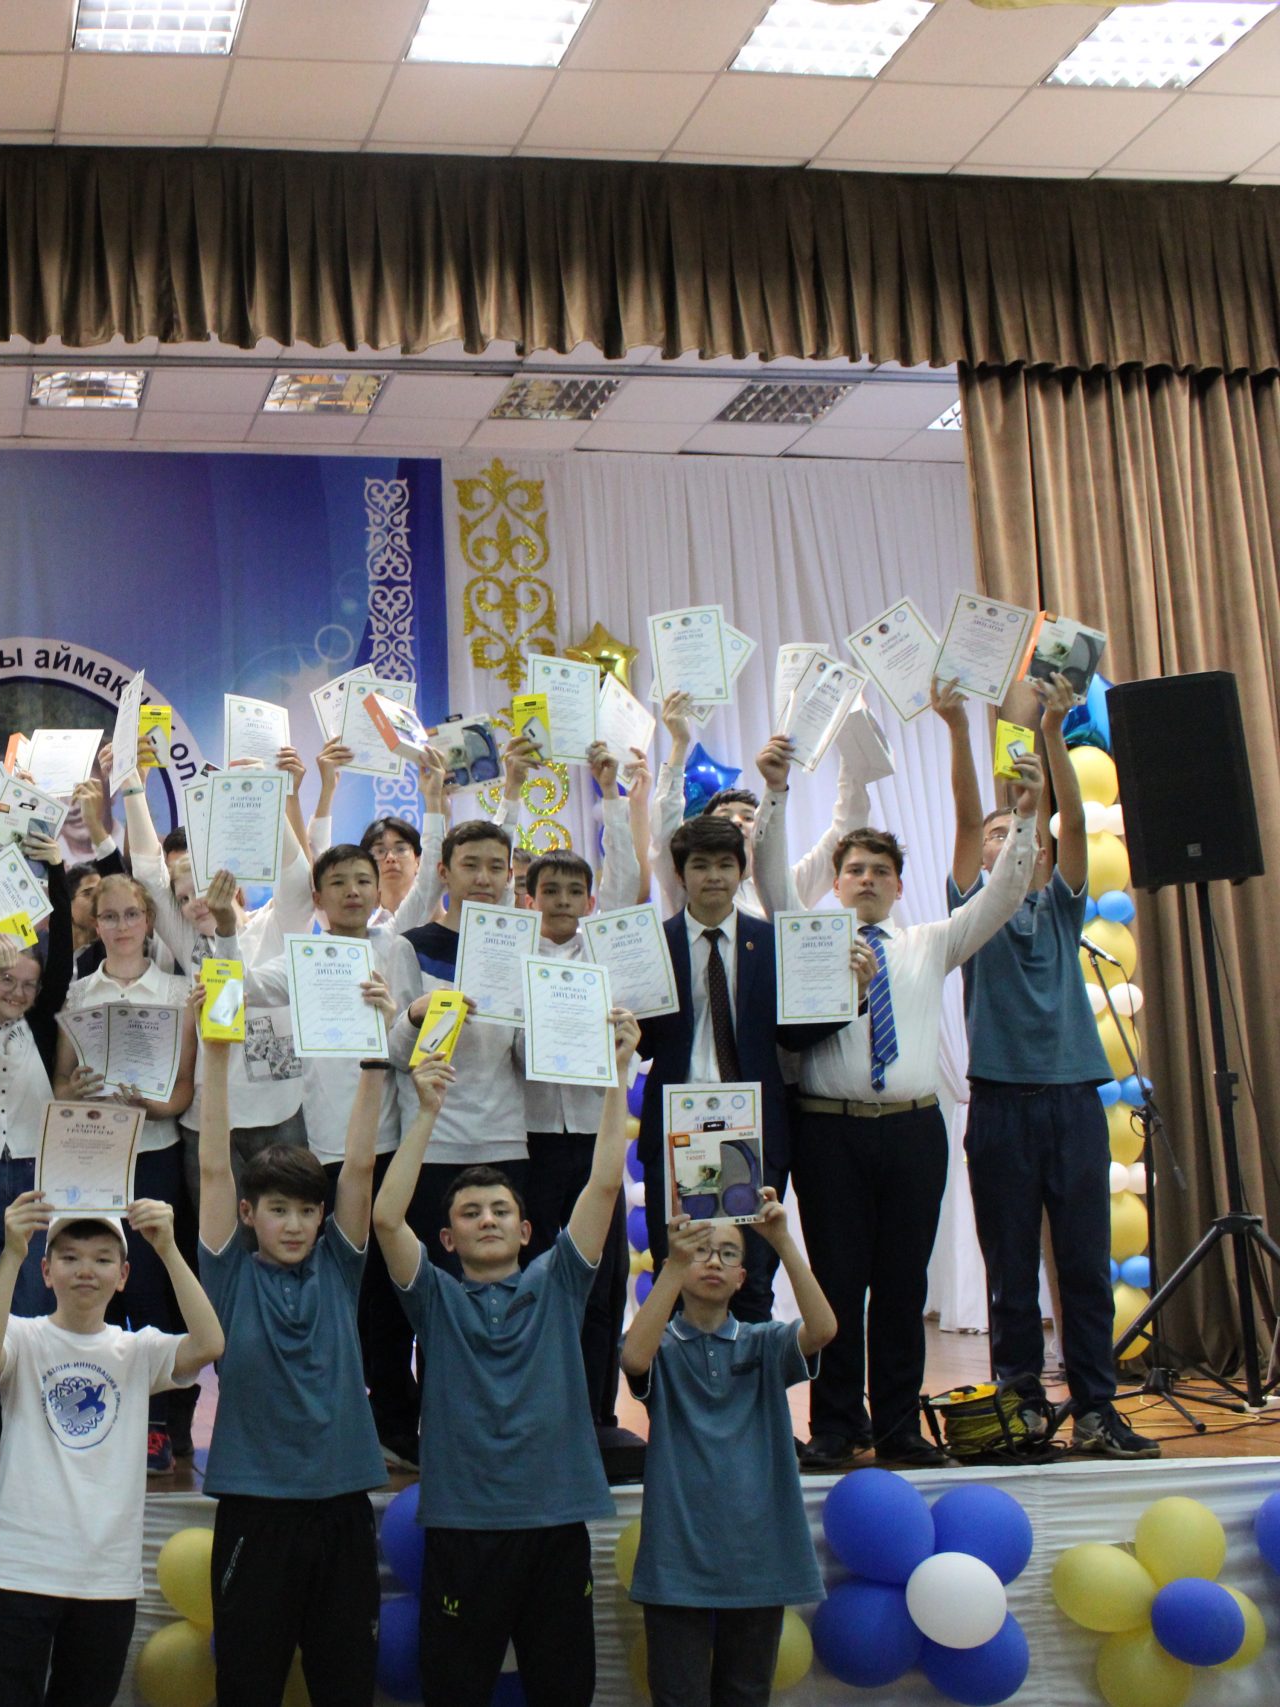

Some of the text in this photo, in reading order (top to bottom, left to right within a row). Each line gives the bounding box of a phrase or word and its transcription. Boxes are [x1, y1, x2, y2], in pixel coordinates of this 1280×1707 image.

[483, 937, 516, 948] ДИПЛОМ
[611, 937, 642, 949] ДИПЛОМ
[315, 968, 352, 977] ДИПЛОМ
[550, 991, 587, 1001] ДИПЛОМ
